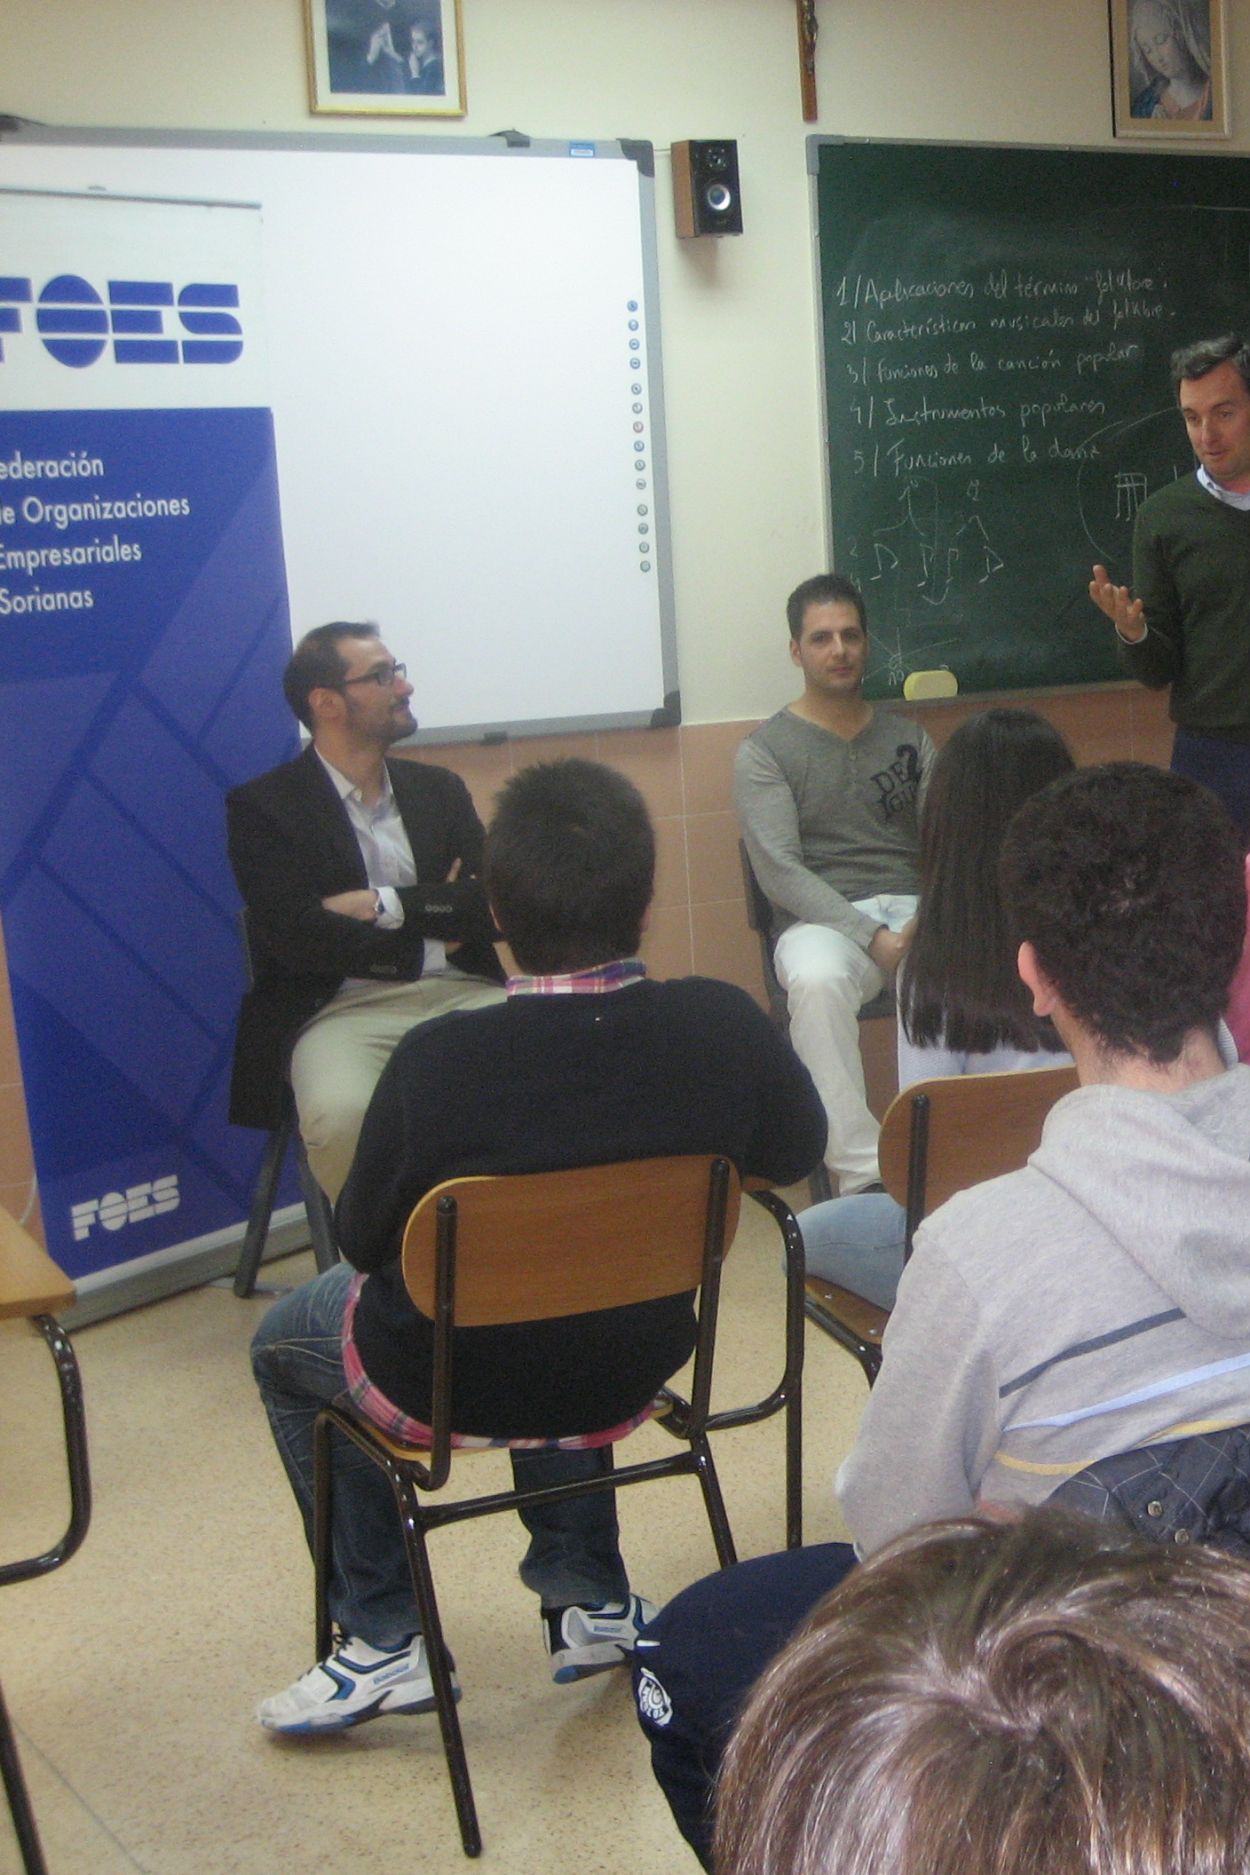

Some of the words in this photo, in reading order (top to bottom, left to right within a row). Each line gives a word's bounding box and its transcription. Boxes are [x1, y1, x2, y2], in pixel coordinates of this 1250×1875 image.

[943, 353, 960, 375] de
[969, 351, 986, 372] la
[998, 350, 1062, 371] canción
[1076, 341, 1139, 375] popular
[0, 450, 105, 480] ederación
[987, 443, 1006, 465] de
[1021, 434, 1038, 463] la
[23, 492, 191, 530] Organizaciones
[0, 586, 94, 615] Sorianas
[71, 1174, 181, 1241] FOES
